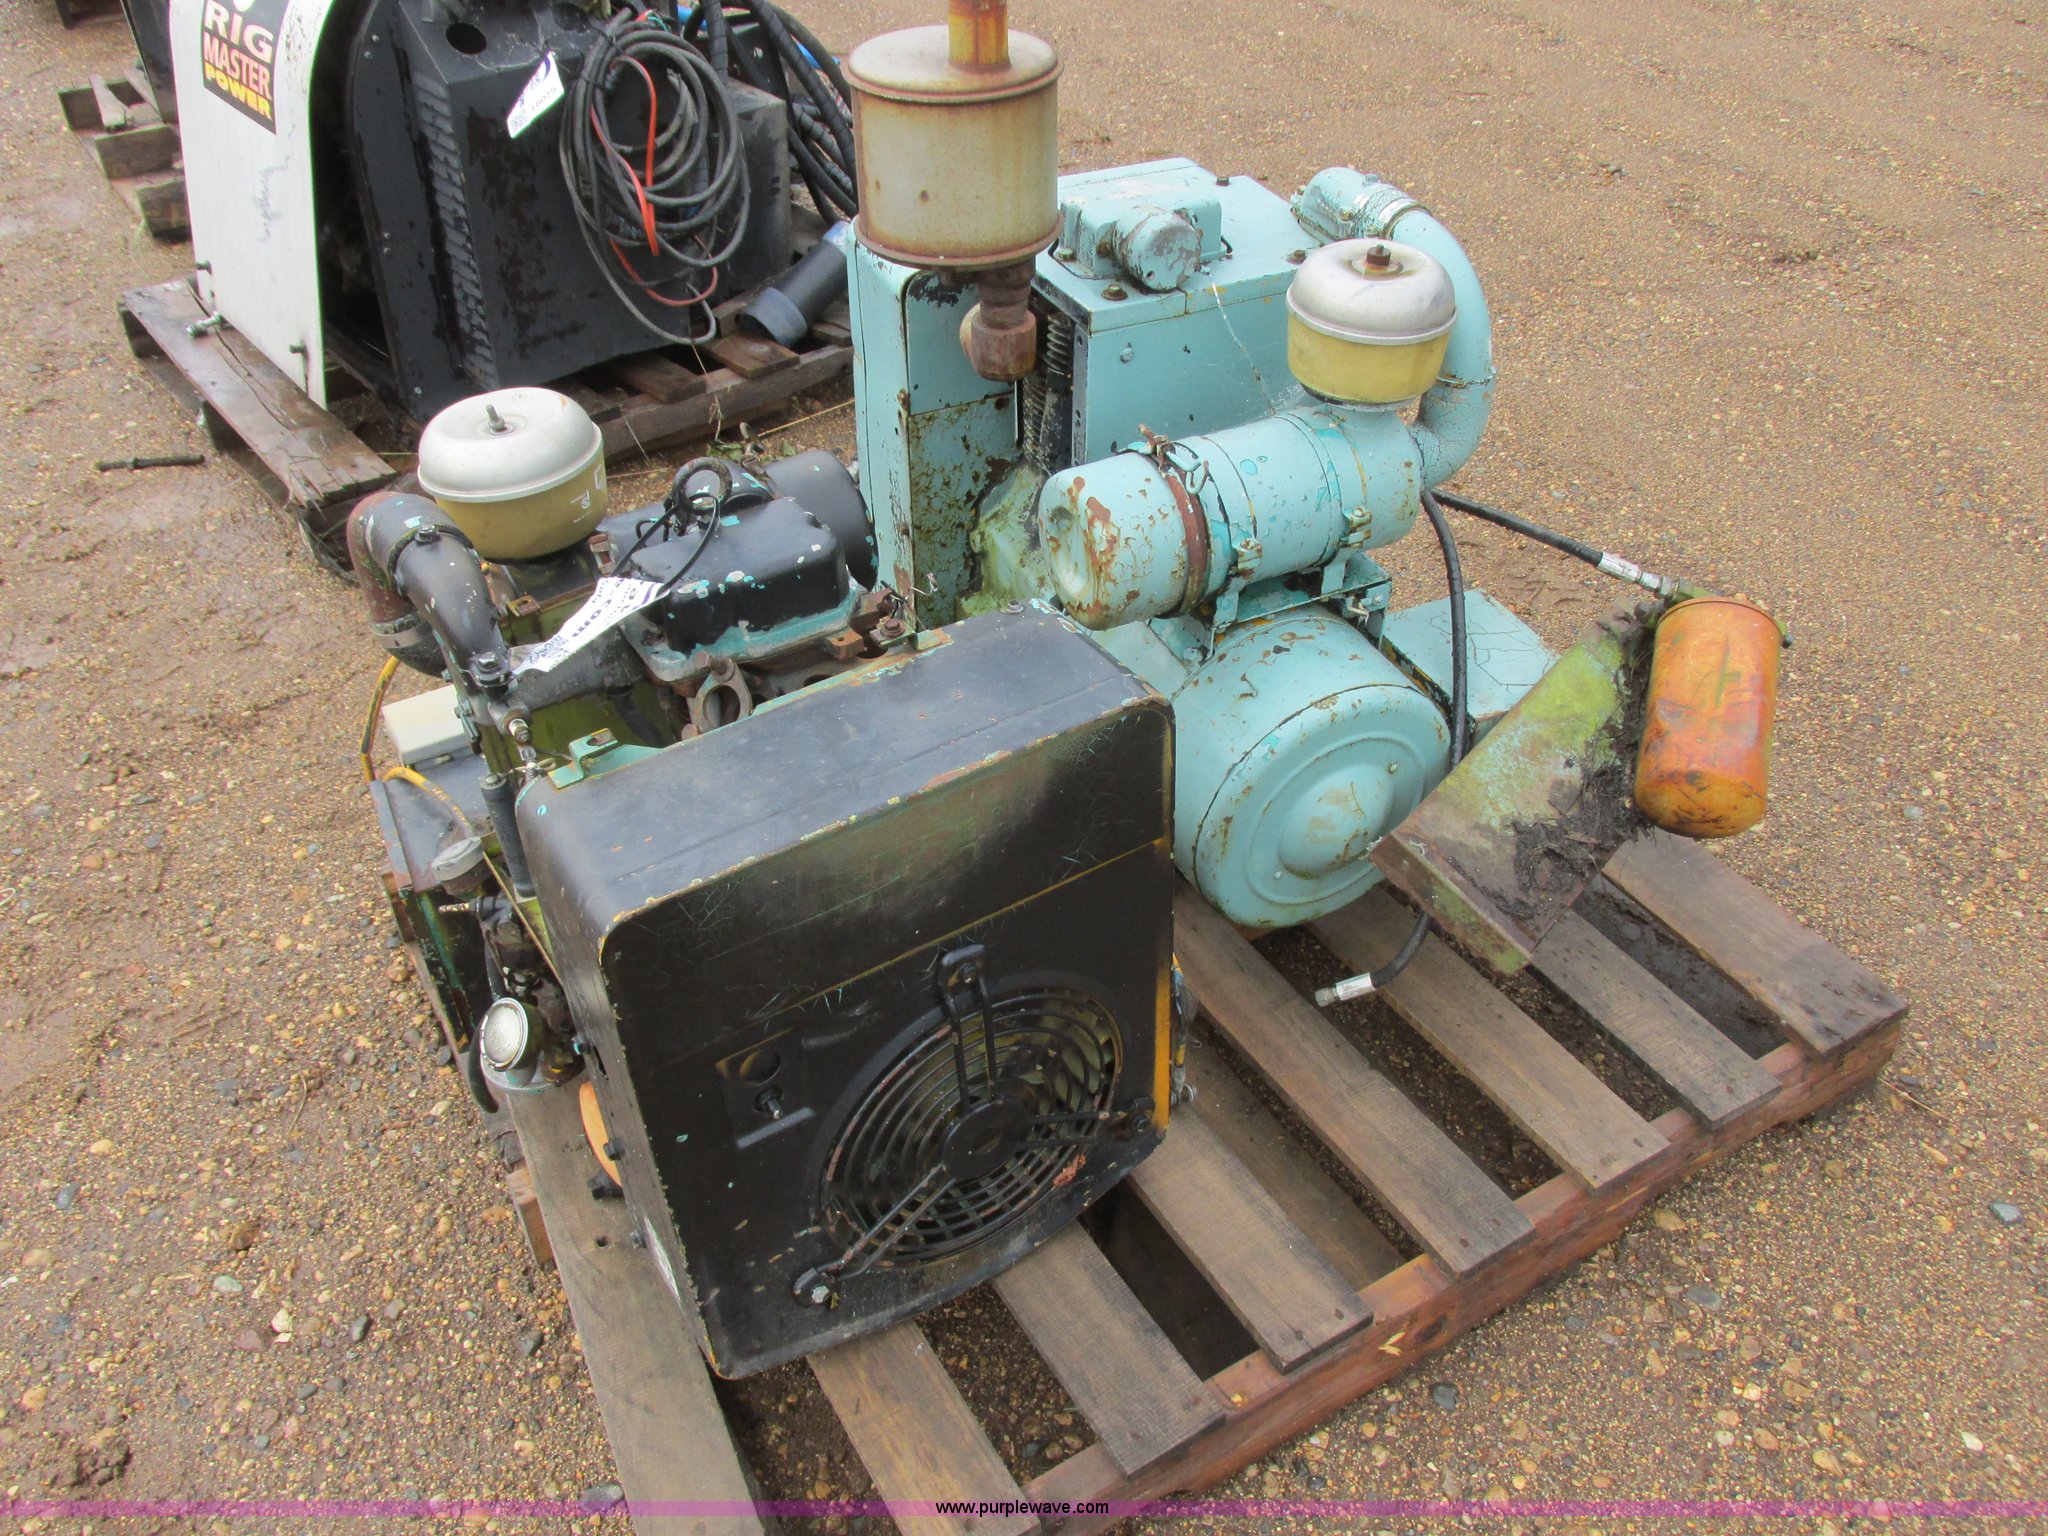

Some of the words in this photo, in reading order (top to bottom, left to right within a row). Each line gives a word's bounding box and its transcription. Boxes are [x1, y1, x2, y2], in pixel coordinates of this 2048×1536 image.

[205, 0, 274, 63] RIG
[204, 32, 272, 100] MASTER
[204, 61, 272, 120] POWER
